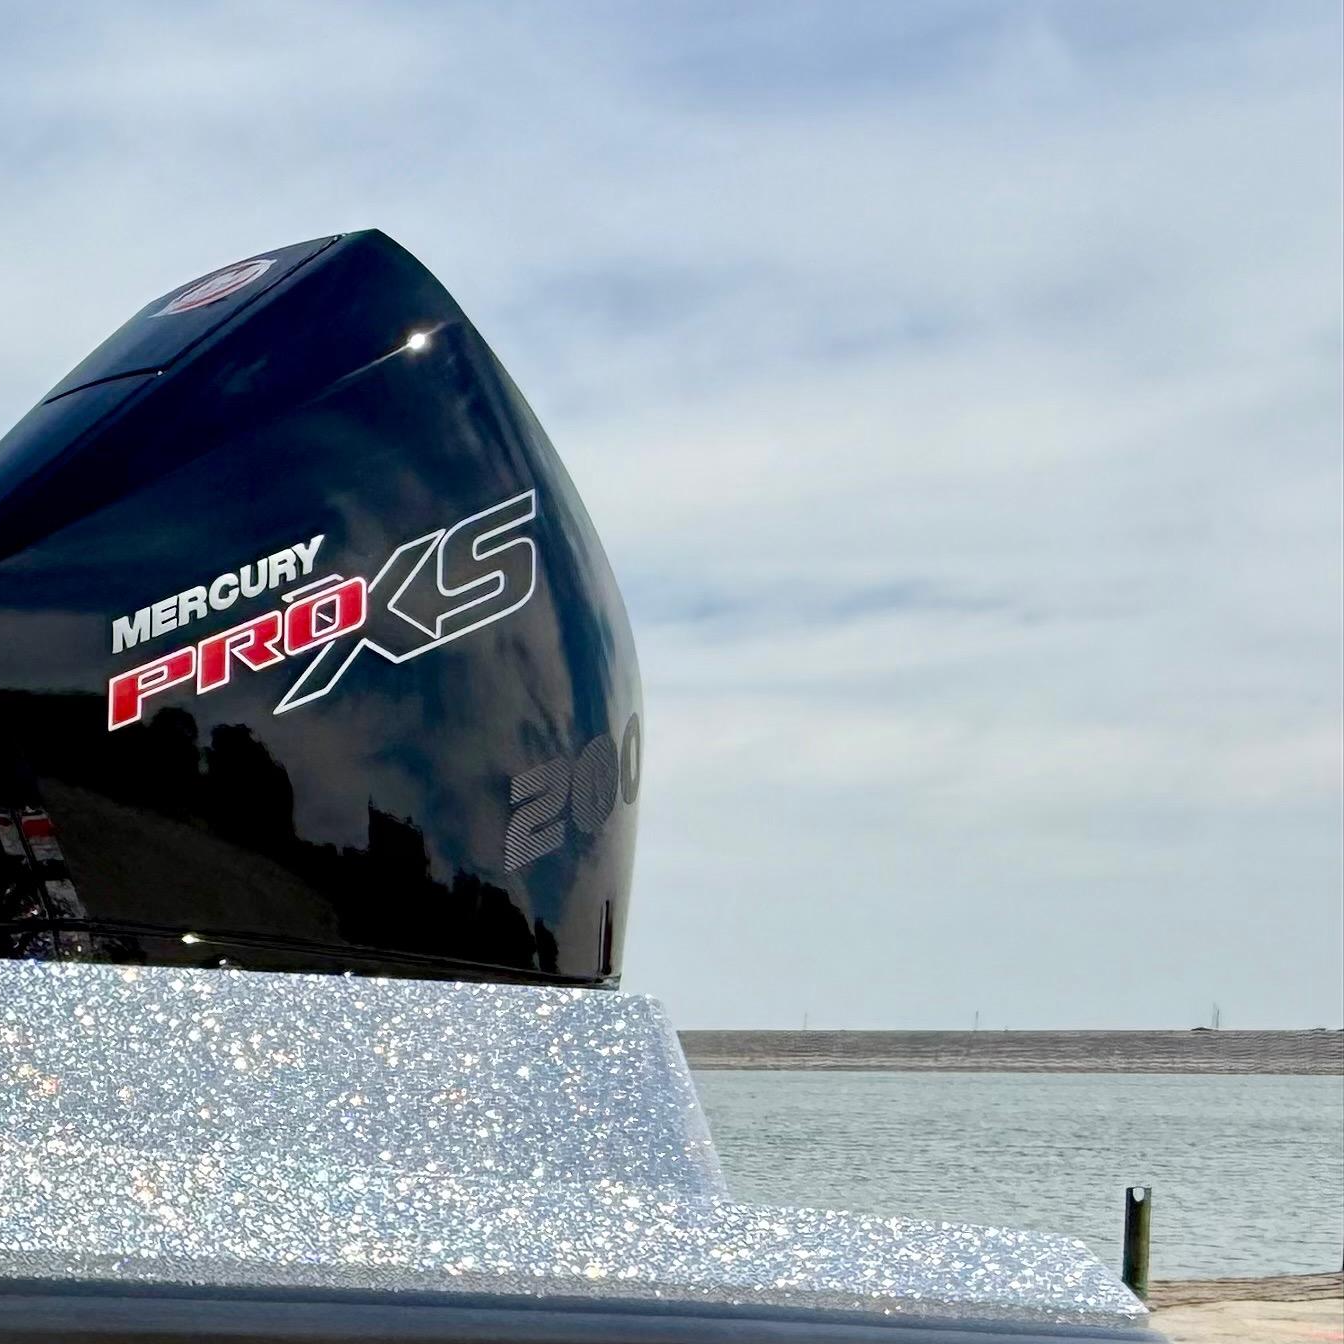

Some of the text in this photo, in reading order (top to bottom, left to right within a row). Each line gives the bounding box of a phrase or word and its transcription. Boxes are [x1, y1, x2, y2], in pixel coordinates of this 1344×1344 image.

[108, 488, 536, 731] PRO XS
[112, 534, 324, 654] MERCURY
